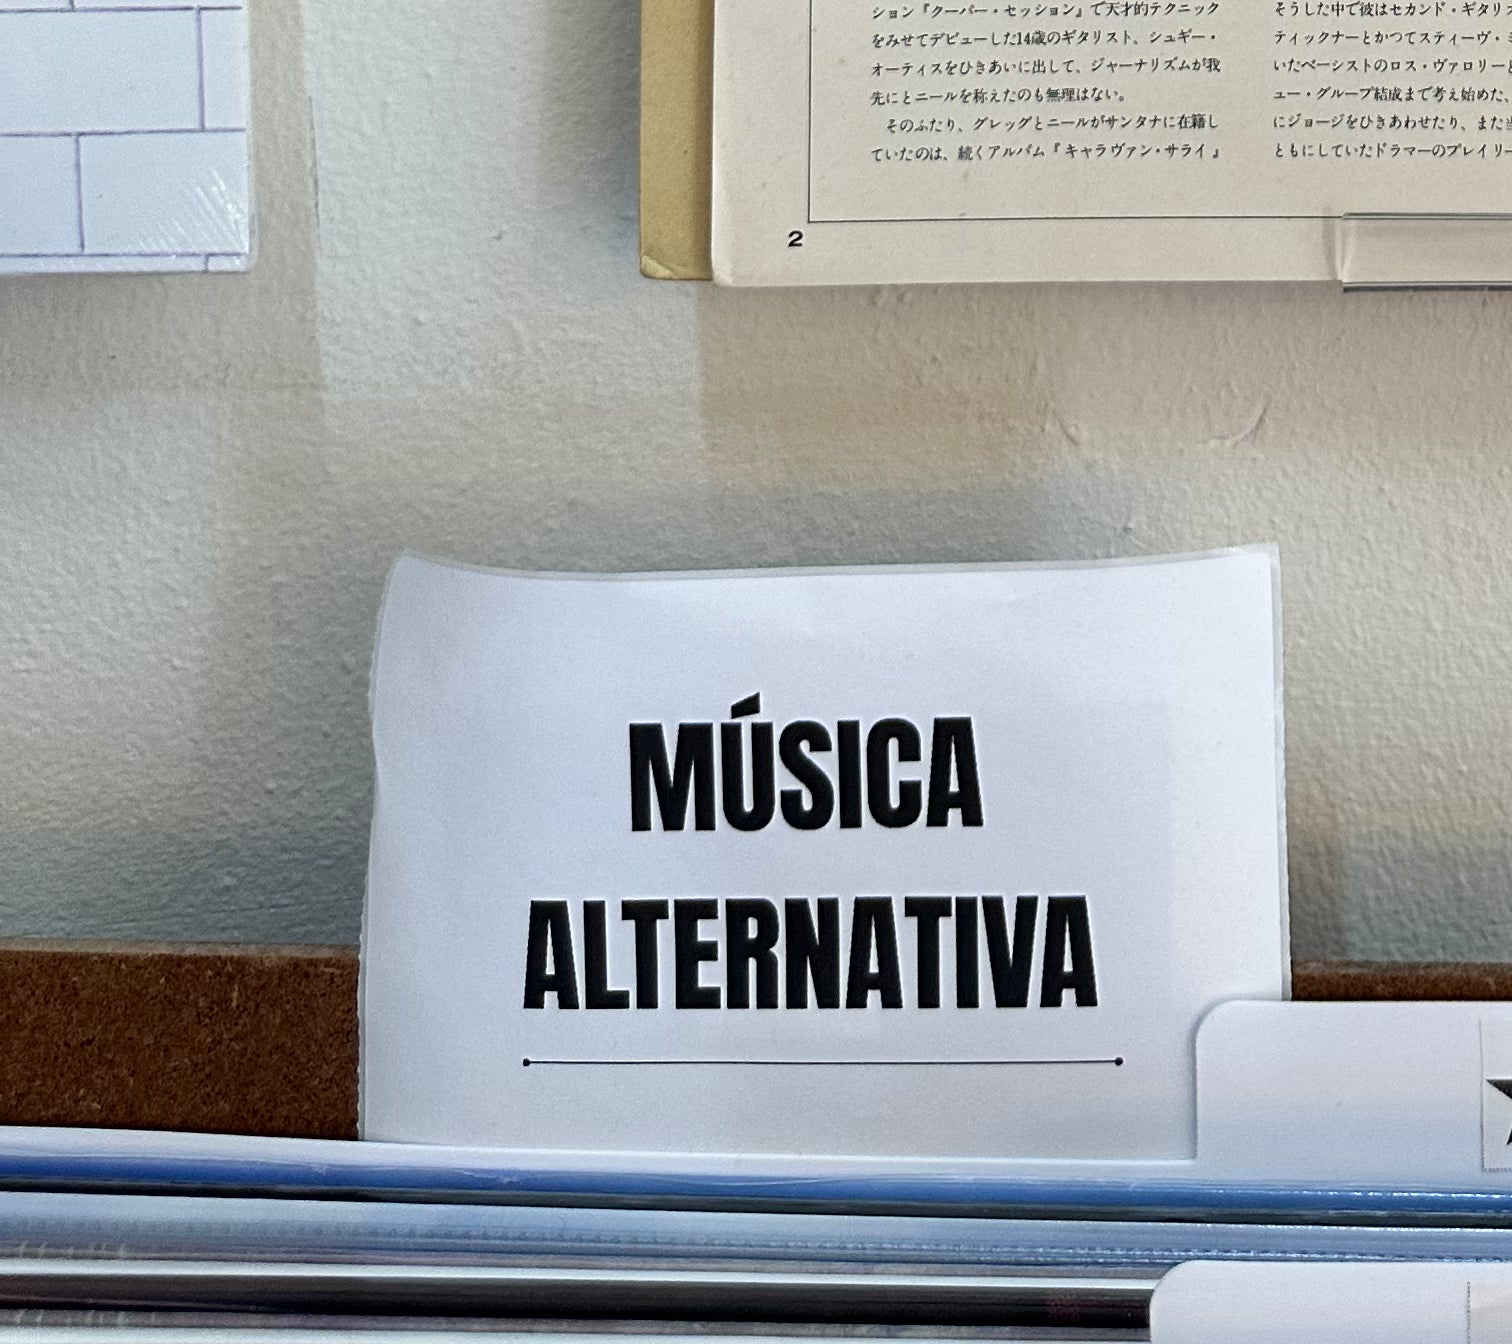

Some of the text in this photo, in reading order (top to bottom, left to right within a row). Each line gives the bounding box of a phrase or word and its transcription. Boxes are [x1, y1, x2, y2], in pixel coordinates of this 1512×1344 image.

[788, 231, 803, 247] 2
[629, 692, 983, 832] MÚSICA
[523, 896, 1098, 1009] ALTERNATIVA
